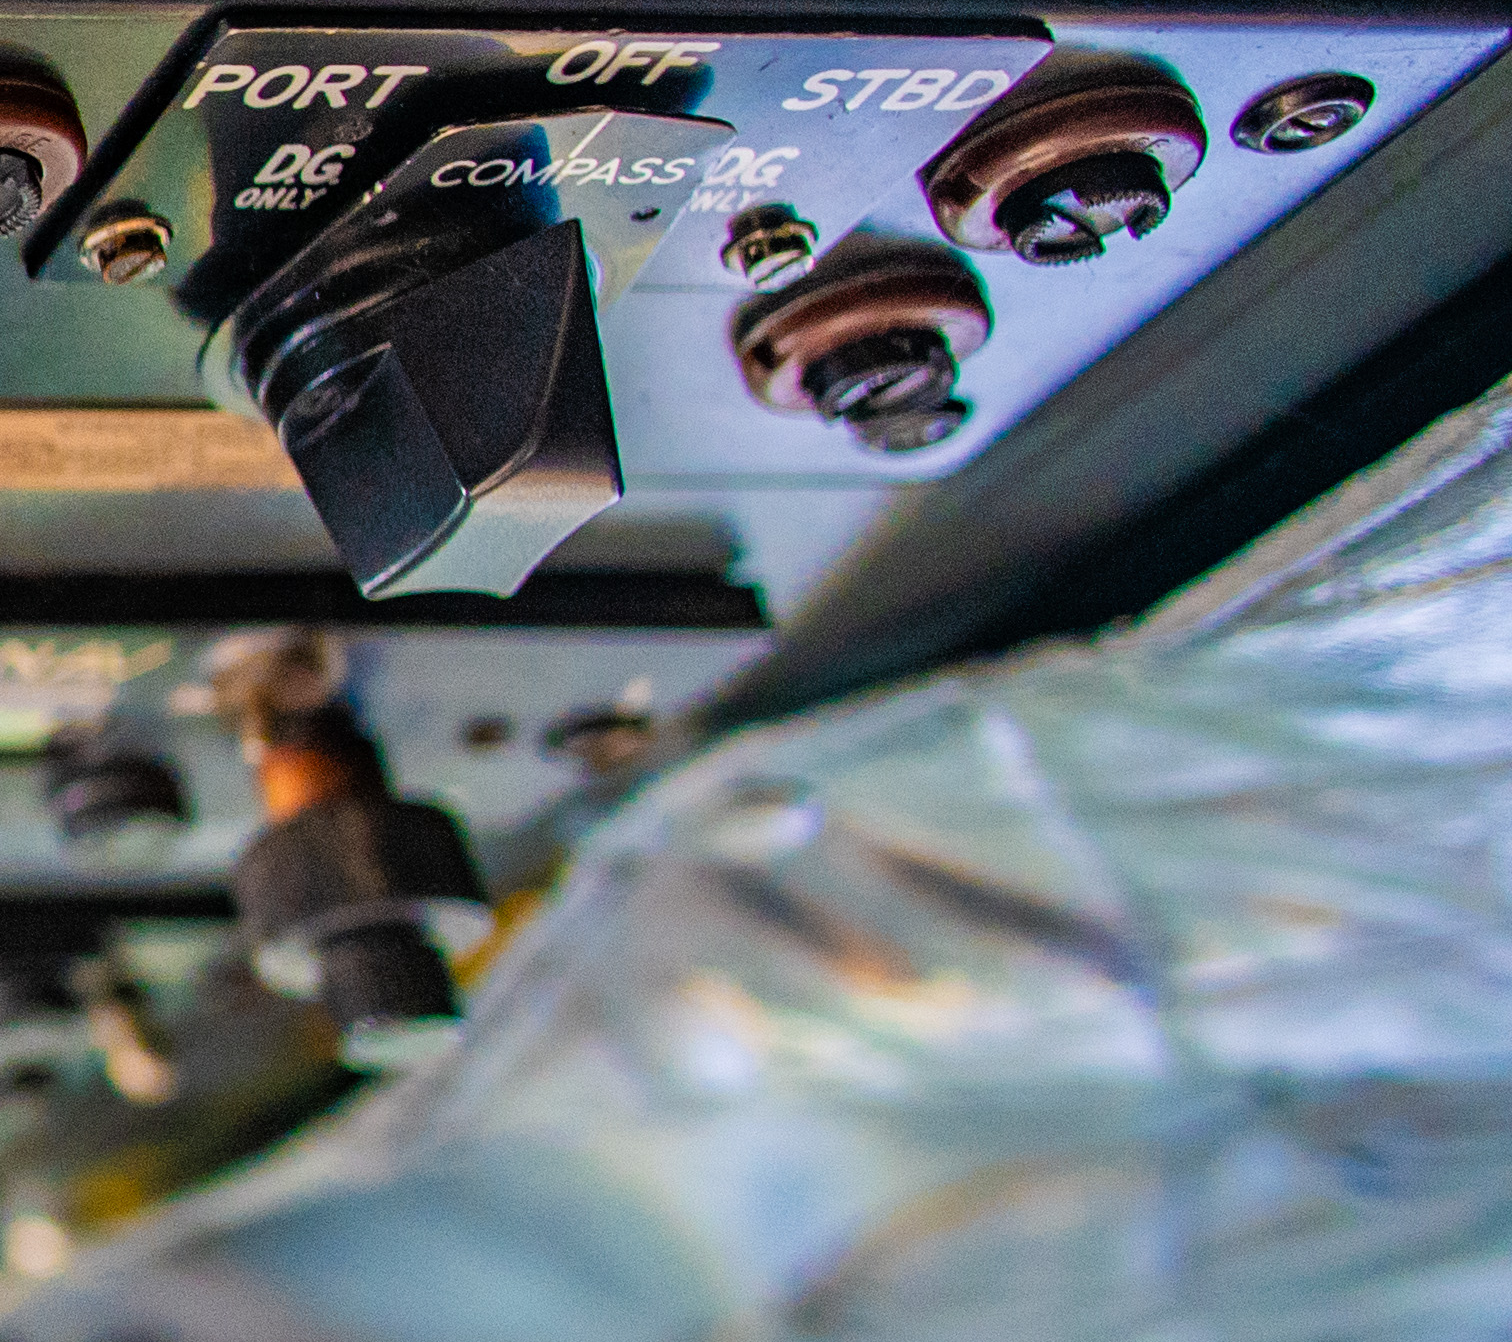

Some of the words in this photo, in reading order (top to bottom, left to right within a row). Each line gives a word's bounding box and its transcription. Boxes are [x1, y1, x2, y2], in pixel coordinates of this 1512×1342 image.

[547, 40, 721, 85] OFF
[183, 64, 430, 110] PORT
[781, 68, 1011, 111] STBD
[430, 156, 696, 188] COMPASS
[234, 186, 328, 210] ONLY
